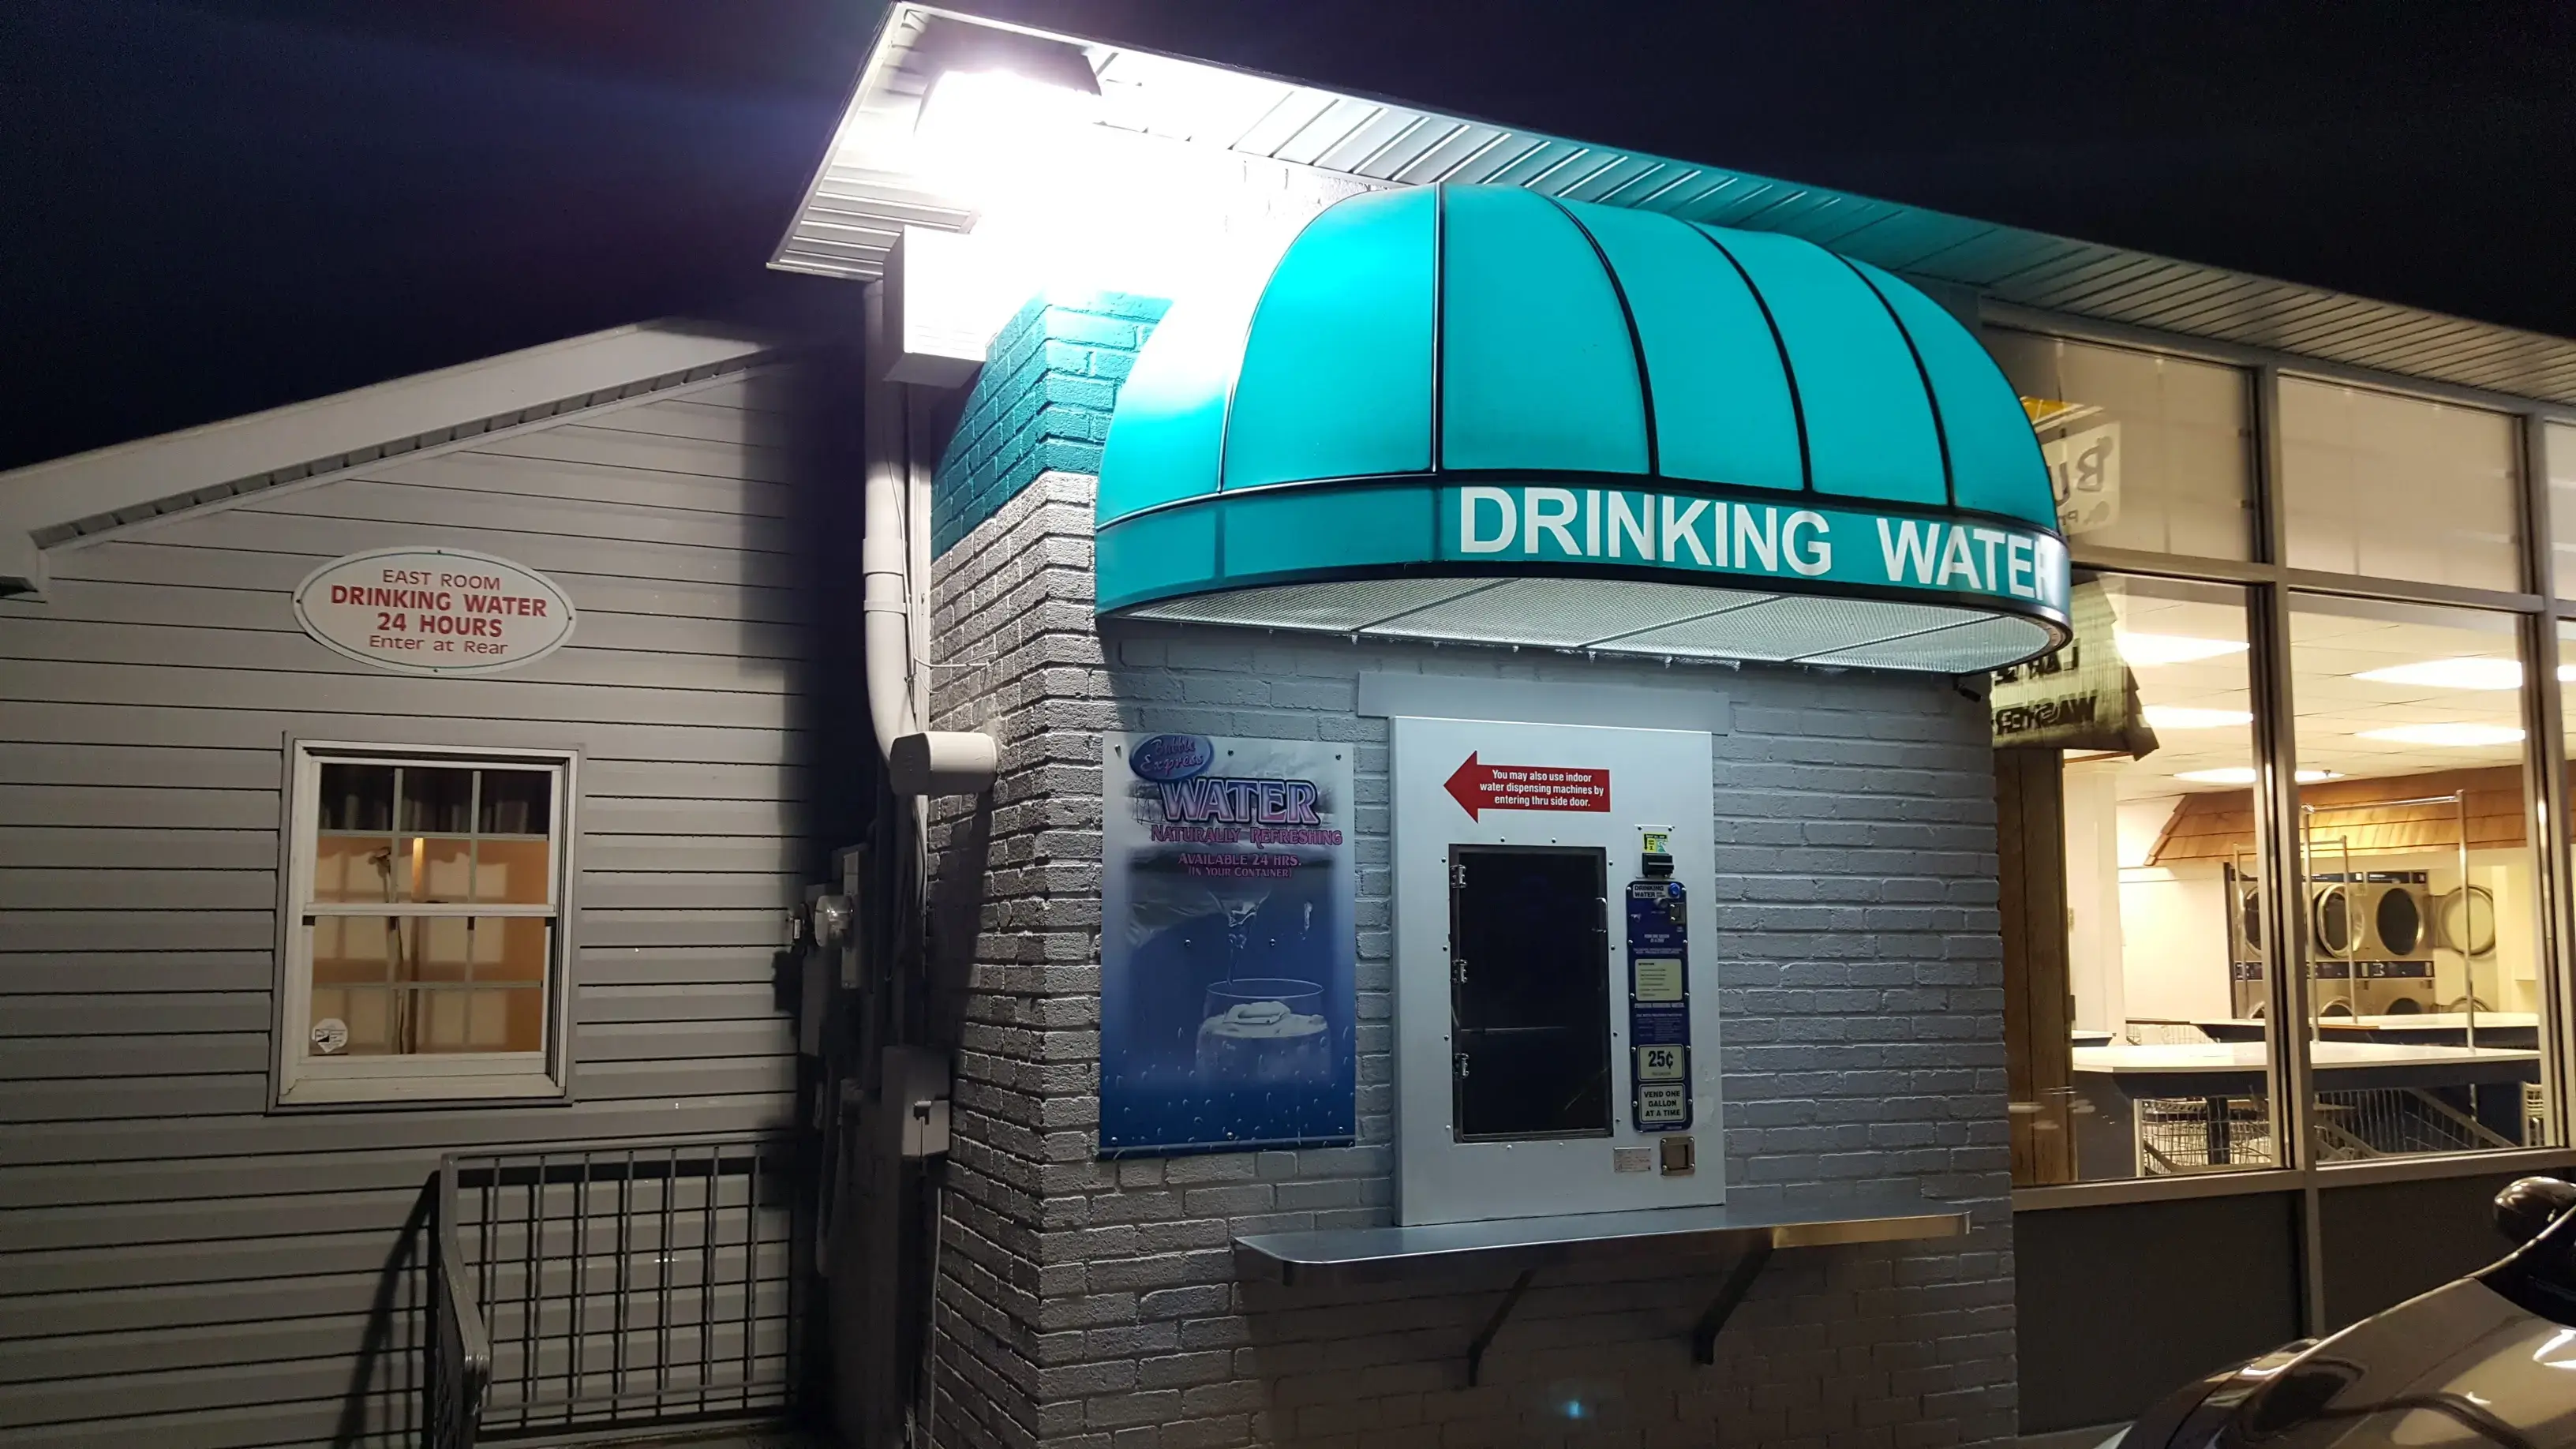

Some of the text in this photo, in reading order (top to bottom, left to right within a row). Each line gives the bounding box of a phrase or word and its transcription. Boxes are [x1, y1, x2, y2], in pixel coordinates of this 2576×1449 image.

[1460, 485, 2058, 606] DRINKING WATER
[383, 568, 500, 590] EAST ROOM
[330, 584, 548, 617] DRINKING WATER
[376, 612, 504, 638] 24 HOURS
[369, 635, 509, 655] Enter at Rear
[1140, 754, 1204, 777] Express
[1492, 769, 1592, 782] You may also use indoor
[1480, 782, 1604, 796] water dispensing machines by
[1158, 776, 1321, 826] WATER
[1494, 795, 1591, 807] entering thru side door.
[1151, 824, 1343, 848] NATURALLY REFRESHING
[1178, 852, 1301, 867] AVAILABLE 24 HRS.
[1188, 866, 1293, 878] (IN YOUR CONTAINER)
[1648, 1050, 1674, 1069] 25¢
